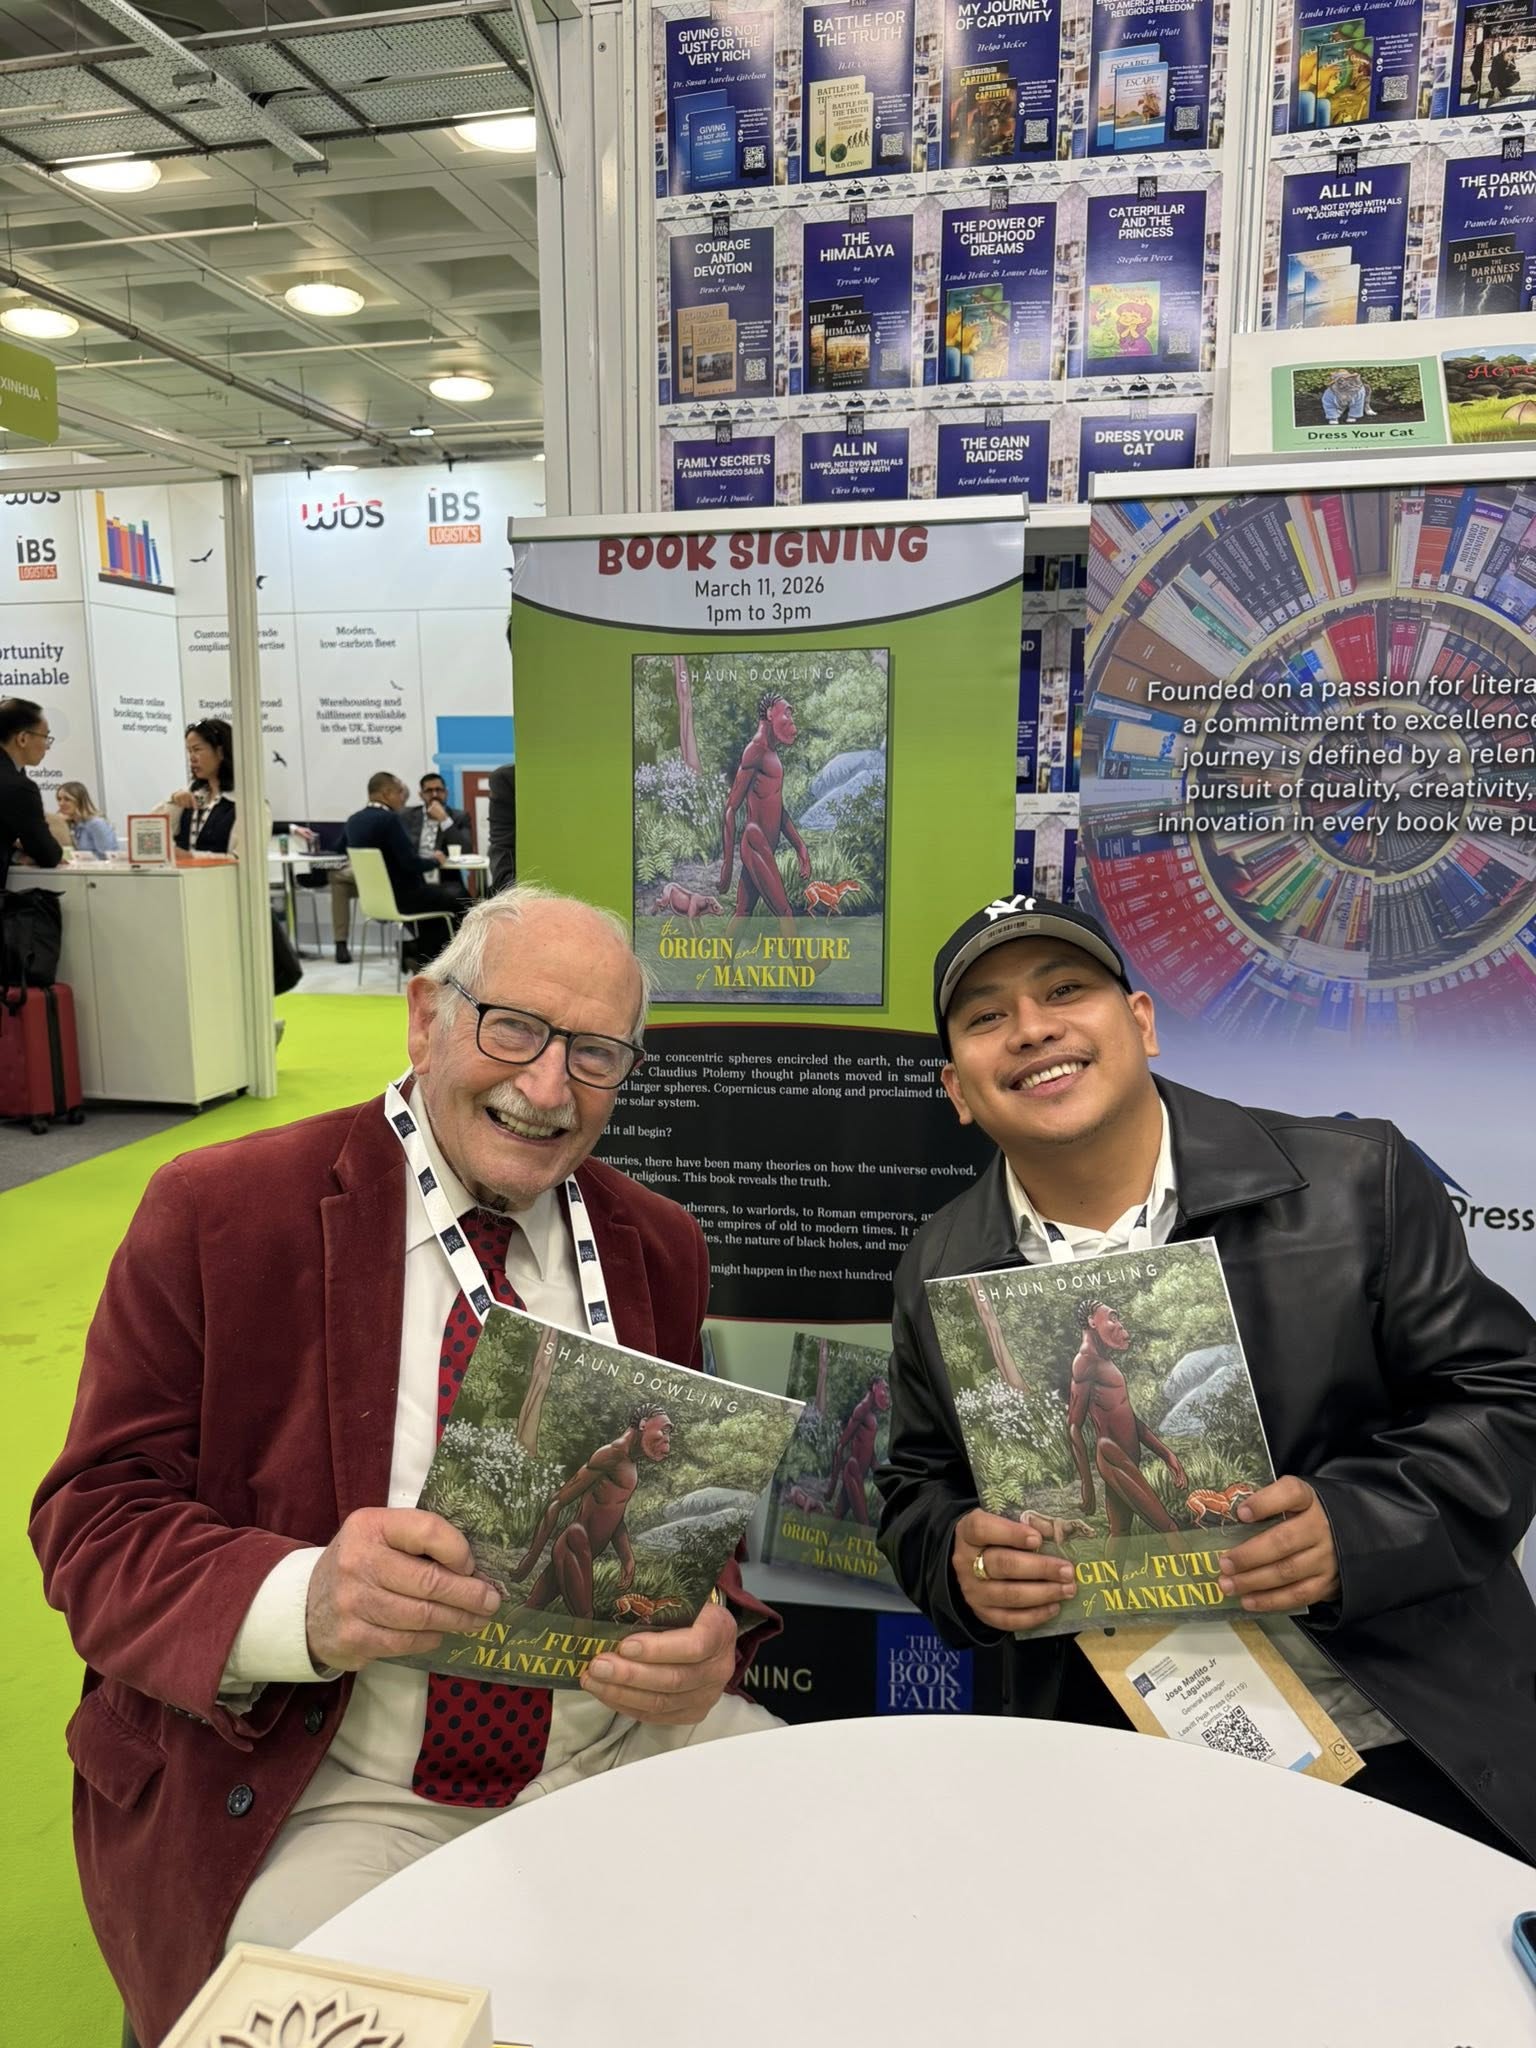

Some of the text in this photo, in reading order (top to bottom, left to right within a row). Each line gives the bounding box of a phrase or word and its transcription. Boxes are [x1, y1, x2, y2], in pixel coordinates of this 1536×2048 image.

[959, 0, 1048, 17] MY JOURNEY
[1111, 3, 1194, 18] RELIGIOUS FREEDOM
[813, 10, 906, 33] BATTLE FOR
[956, 9, 1053, 30] OF CAPTIVITY
[678, 23, 761, 42] GIVING IS NOT
[816, 26, 902, 48] THE TRUTH
[678, 35, 761, 55] JUST FOR THE
[688, 49, 750, 66] VERY RICH
[1319, 180, 1372, 199] ALL IN
[1460, 175, 1487, 188] THE
[1477, 187, 1497, 199] AT
[1109, 204, 1185, 218] CATERPILLAR
[1314, 208, 1350, 219] JOURNEY
[1351, 207, 1363, 215] OF
[1363, 206, 1387, 214] FAITH
[1321, 203, 1337, 211] NOT
[1338, 200, 1363, 210] DYING
[1364, 199, 1386, 207] WITH
[1387, 197, 1402, 205] ALS
[952, 216, 1046, 233] THE POWER OF
[1122, 215, 1171, 229] AND THE
[842, 232, 870, 246] THE
[960, 229, 1036, 245] CHILDHOOD
[1118, 227, 1174, 239] PRINCESS
[695, 238, 751, 254] COURAGE
[820, 244, 895, 262] HIMALAYA
[970, 242, 1025, 257] DREAMS
[711, 252, 735, 264] AND
[694, 262, 752, 277] DEVOTION
[1471, 263, 1520, 277] DARKNESS
[1486, 274, 1513, 285] DAWN
[1, 377, 41, 400] XINHUA
[960, 435, 1030, 450] THE GANN
[1095, 429, 1184, 443] DRESS YOUR
[1308, 428, 1414, 440] Dress Your Cat
[832, 442, 878, 457] ALL IN
[966, 449, 1024, 463] RAIDERS
[1123, 443, 1155, 455] CAT
[677, 454, 771, 469] FAMILY SECRETS
[688, 470, 702, 478] SAN
[703, 469, 743, 477] FRANCISCO
[744, 468, 764, 476] SAGA
[598, 525, 928, 576] BOOK SIGNING
[18, 564, 57, 581] LOGISTICS
[694, 576, 825, 598] March 11, 2026
[706, 603, 812, 626] 1pm to 3pm
[680, 667, 835, 682] SHAUN DOWLING
[1147, 674, 1464, 702] Founded on a passion for
[383, 697, 401, 707] and
[1182, 710, 1397, 734] a commitment to
[1180, 742, 1461, 772] journey is defined by a
[1186, 777, 1535, 805] pursuit of quality, creativity,
[1158, 811, 1503, 837] innovation in every book we
[660, 916, 681, 937] the
[659, 932, 851, 960] ORIGIN and FUTURE
[696, 965, 816, 990] of MANKIND
[665, 1052, 772, 1066] concentric spheres
[648, 1066, 793, 1081] Claudius Ptolemy thought
[714, 1083, 932, 1099] Copernicus along proclaimed
[638, 1126, 672, 1139] begin?
[683, 1172, 707, 1183] This
[710, 1173, 736, 1184] book
[738, 1175, 777, 1186] reveals
[800, 1177, 831, 1188] truth.
[743, 1264, 784, 1278] happen
[978, 1263, 1158, 1303] SHAUN DOWLING
[544, 1342, 738, 1413] SHAUN DOWLING
[782, 1520, 829, 1546] ORIGIN
[814, 1548, 878, 1577] MANKIND
[1122, 1551, 1149, 1582] and
[1082, 1581, 1224, 1618] of MANKIND
[905, 1635, 943, 1650] THE
[889, 1648, 962, 1667] LONDON
[888, 1661, 961, 1688] BOOK
[1165, 1657, 1217, 1701] Jose Jr
[1180, 1675, 1212, 1700] Lagubis
[888, 1684, 962, 1711] FAIR
